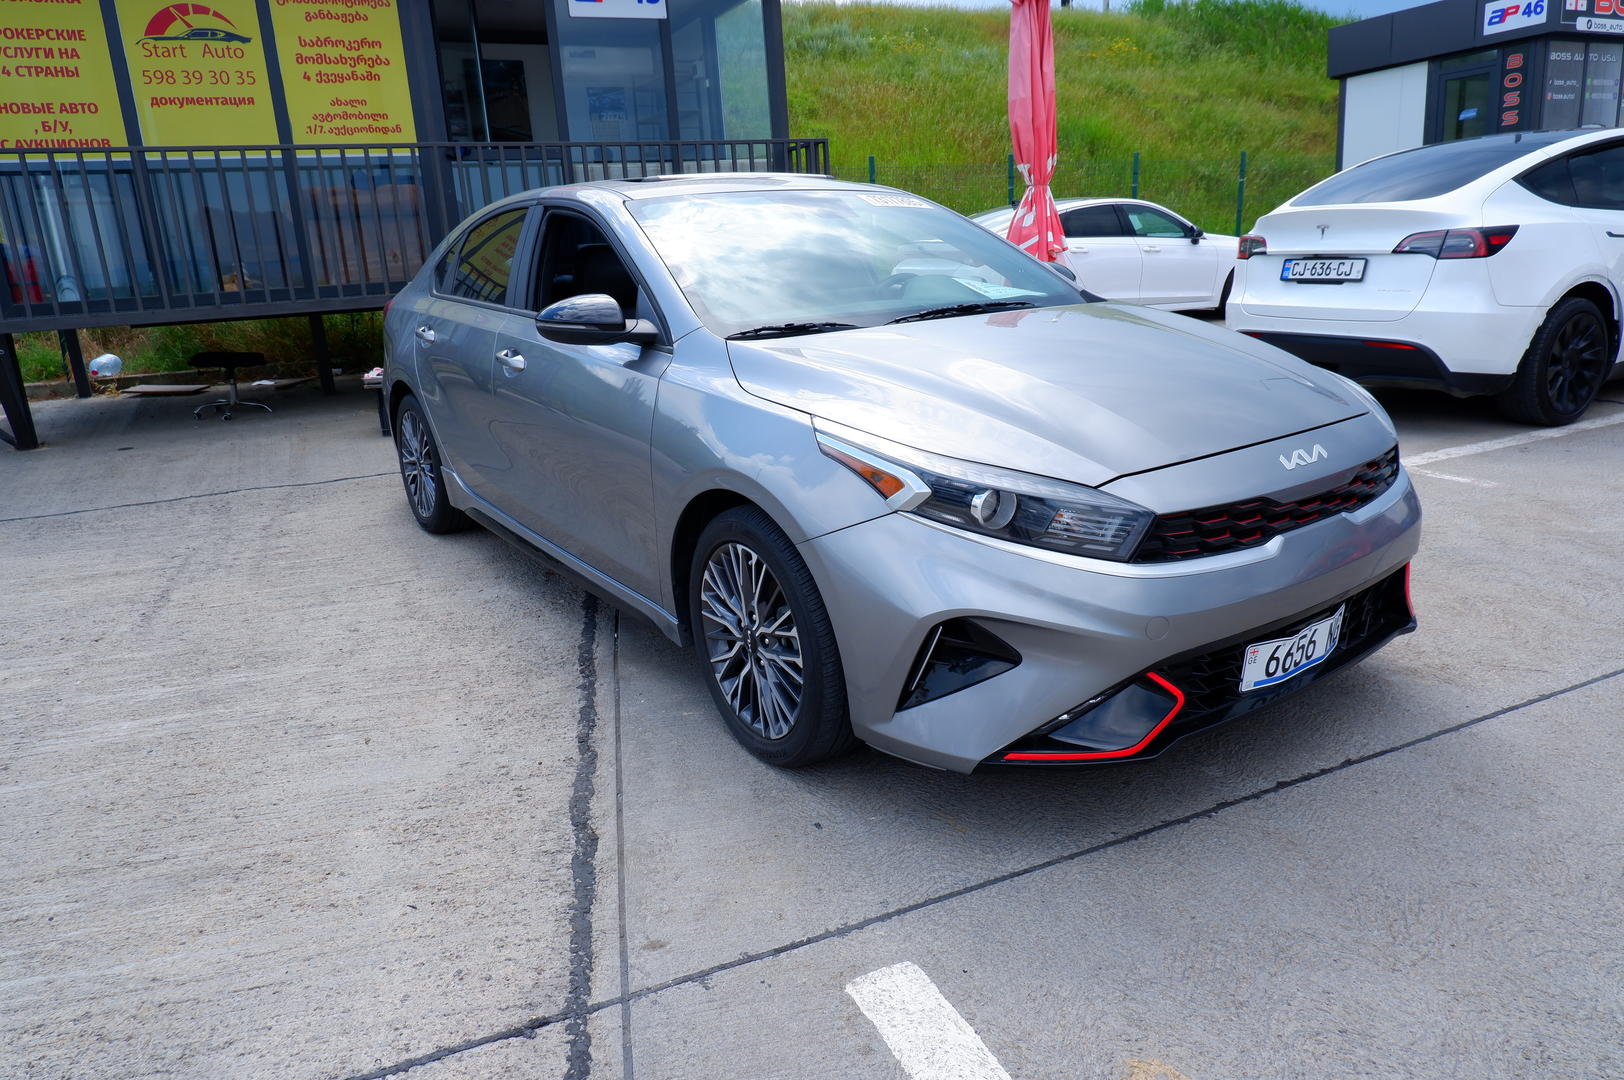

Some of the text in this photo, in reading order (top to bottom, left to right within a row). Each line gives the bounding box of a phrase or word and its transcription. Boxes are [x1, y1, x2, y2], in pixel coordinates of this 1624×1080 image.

[1522, 0, 1545, 17] 46
[298, 36, 382, 51] საბროკერო
[58, 47, 81, 59] НА
[141, 42, 245, 59] Start Auto
[295, 53, 391, 68] მომსახურება
[1602, 53, 1617, 62] USA
[2, 65, 80, 78] 4 СТРАНЫ
[142, 70, 256, 86] 598 39 30 35
[303, 70, 381, 84] 4 ქვეყანაში
[0, 102, 99, 115] НОВЫЕ АВТО
[150, 96, 256, 109] документация
[330, 97, 367, 108] ახალი
[312, 110, 389, 123] ავტომობილი
[1291, 261, 1354, 277] CJ-636-CJ
[1264, 628, 1319, 678] 6656
[1247, 655, 1258, 665] GE
